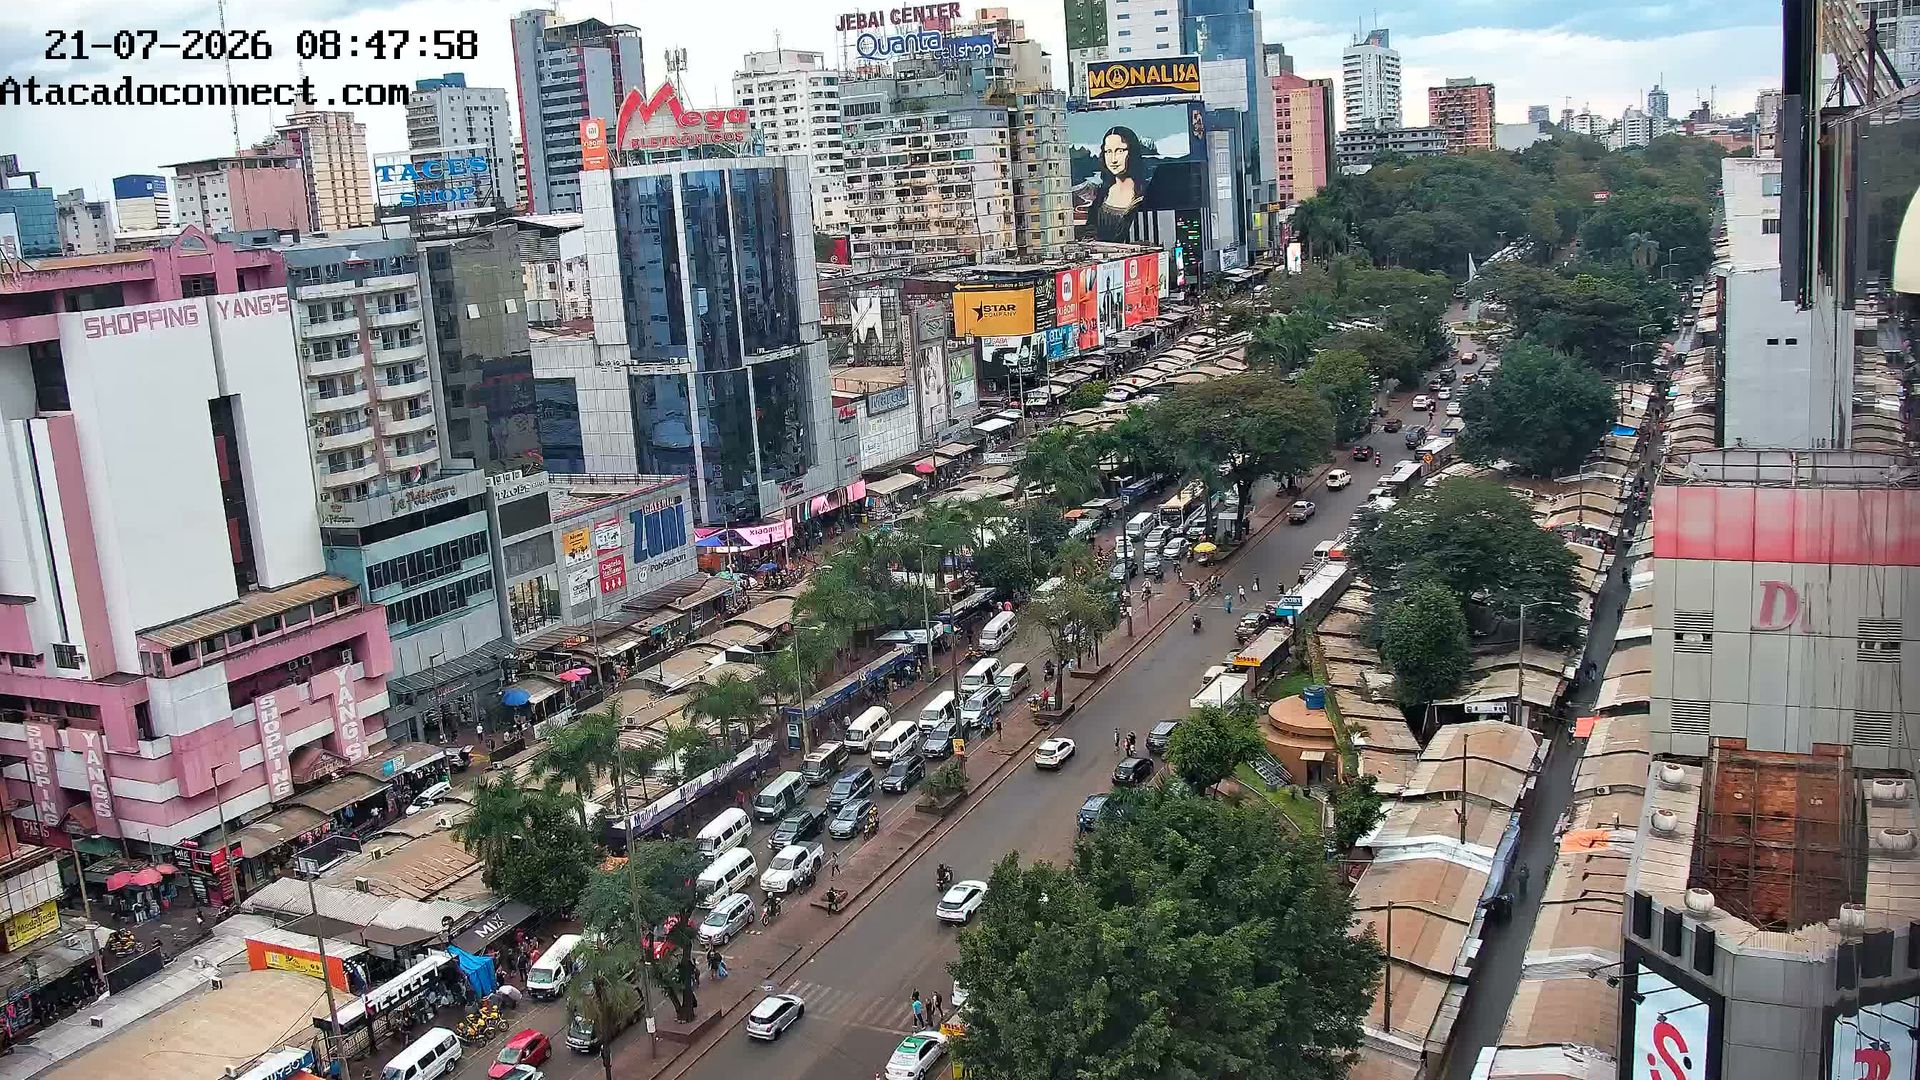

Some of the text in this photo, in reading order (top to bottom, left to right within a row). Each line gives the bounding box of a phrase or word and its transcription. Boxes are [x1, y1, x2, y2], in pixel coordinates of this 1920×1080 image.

[835, 2, 962, 32] JEBAI CENTER
[857, 26, 942, 60] Quanta
[1088, 63, 1199, 90] MONALISA
[616, 81, 750, 157] Mega
[401, 186, 476, 207] SHOP
[84, 293, 290, 339] SHOPPING YANG'S
[983, 304, 1017, 313] STAR
[650, 552, 687, 572] PolyStation
[259, 695, 292, 796] SHOPPING
[26, 724, 60, 826] SHOPPING
[679, 778, 703, 800] Madrid
[634, 804, 659, 826] Madrid
[474, 913, 505, 938] MIX
